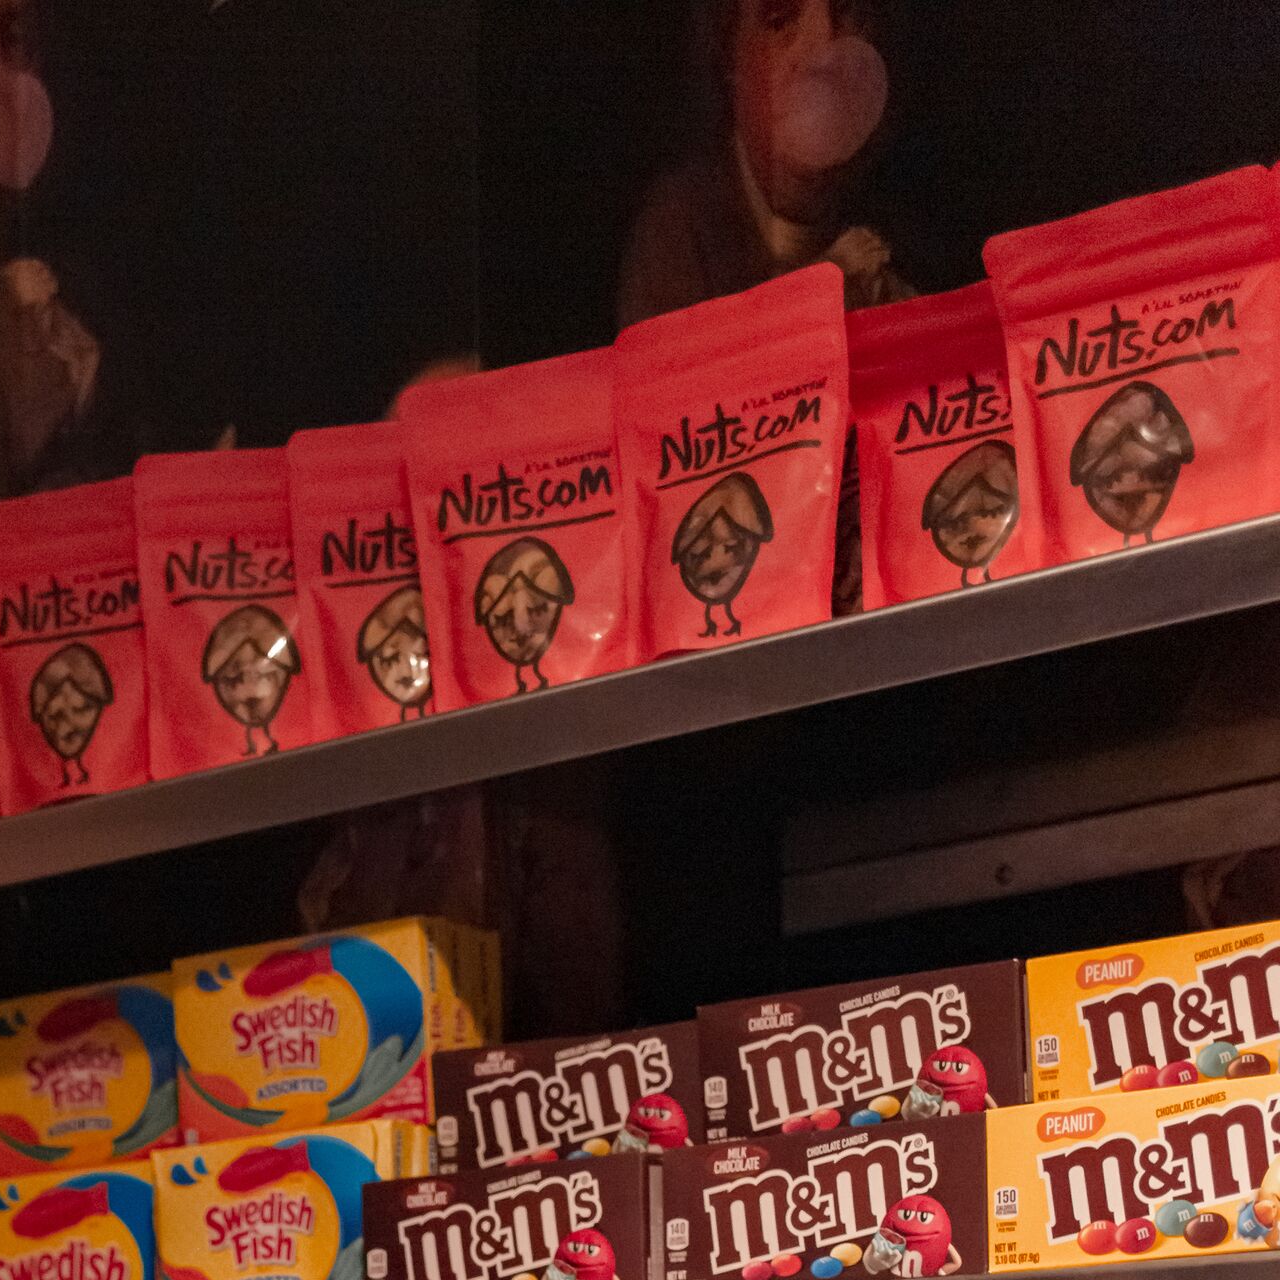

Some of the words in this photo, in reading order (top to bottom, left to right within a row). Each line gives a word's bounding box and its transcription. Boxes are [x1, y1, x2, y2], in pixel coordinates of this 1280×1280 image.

[895, 373, 1010, 443] Nuts.
[1194, 942, 1232, 962] CHOCOLATE
[1233, 933, 1265, 951] CANDIES
[1084, 959, 1134, 983] PEANUT
[761, 1003, 780, 1016] MILK
[233, 997, 336, 1052] Swedish
[748, 1014, 794, 1031] CHOCOLATE
[257, 1033, 315, 1070] Fish
[1038, 1038, 1057, 1053] 150
[52, 1073, 105, 1109] Fish
[257, 1077, 328, 1100] ASSORTED
[1156, 1101, 1195, 1119] CHOCOLATE
[1196, 1091, 1227, 1109] CANDIES
[1046, 1112, 1096, 1136] PEANUT
[727, 1147, 747, 1158] MILK
[713, 1157, 760, 1175] CHOCOLATE
[996, 1189, 1016, 1204] 150
[205, 1192, 314, 1246] Swedish
[232, 1230, 293, 1265] Fish
[995, 1243, 1006, 1253] NET
[1007, 1242, 1017, 1252] WT
[1008, 1253, 1017, 1264] OZ
